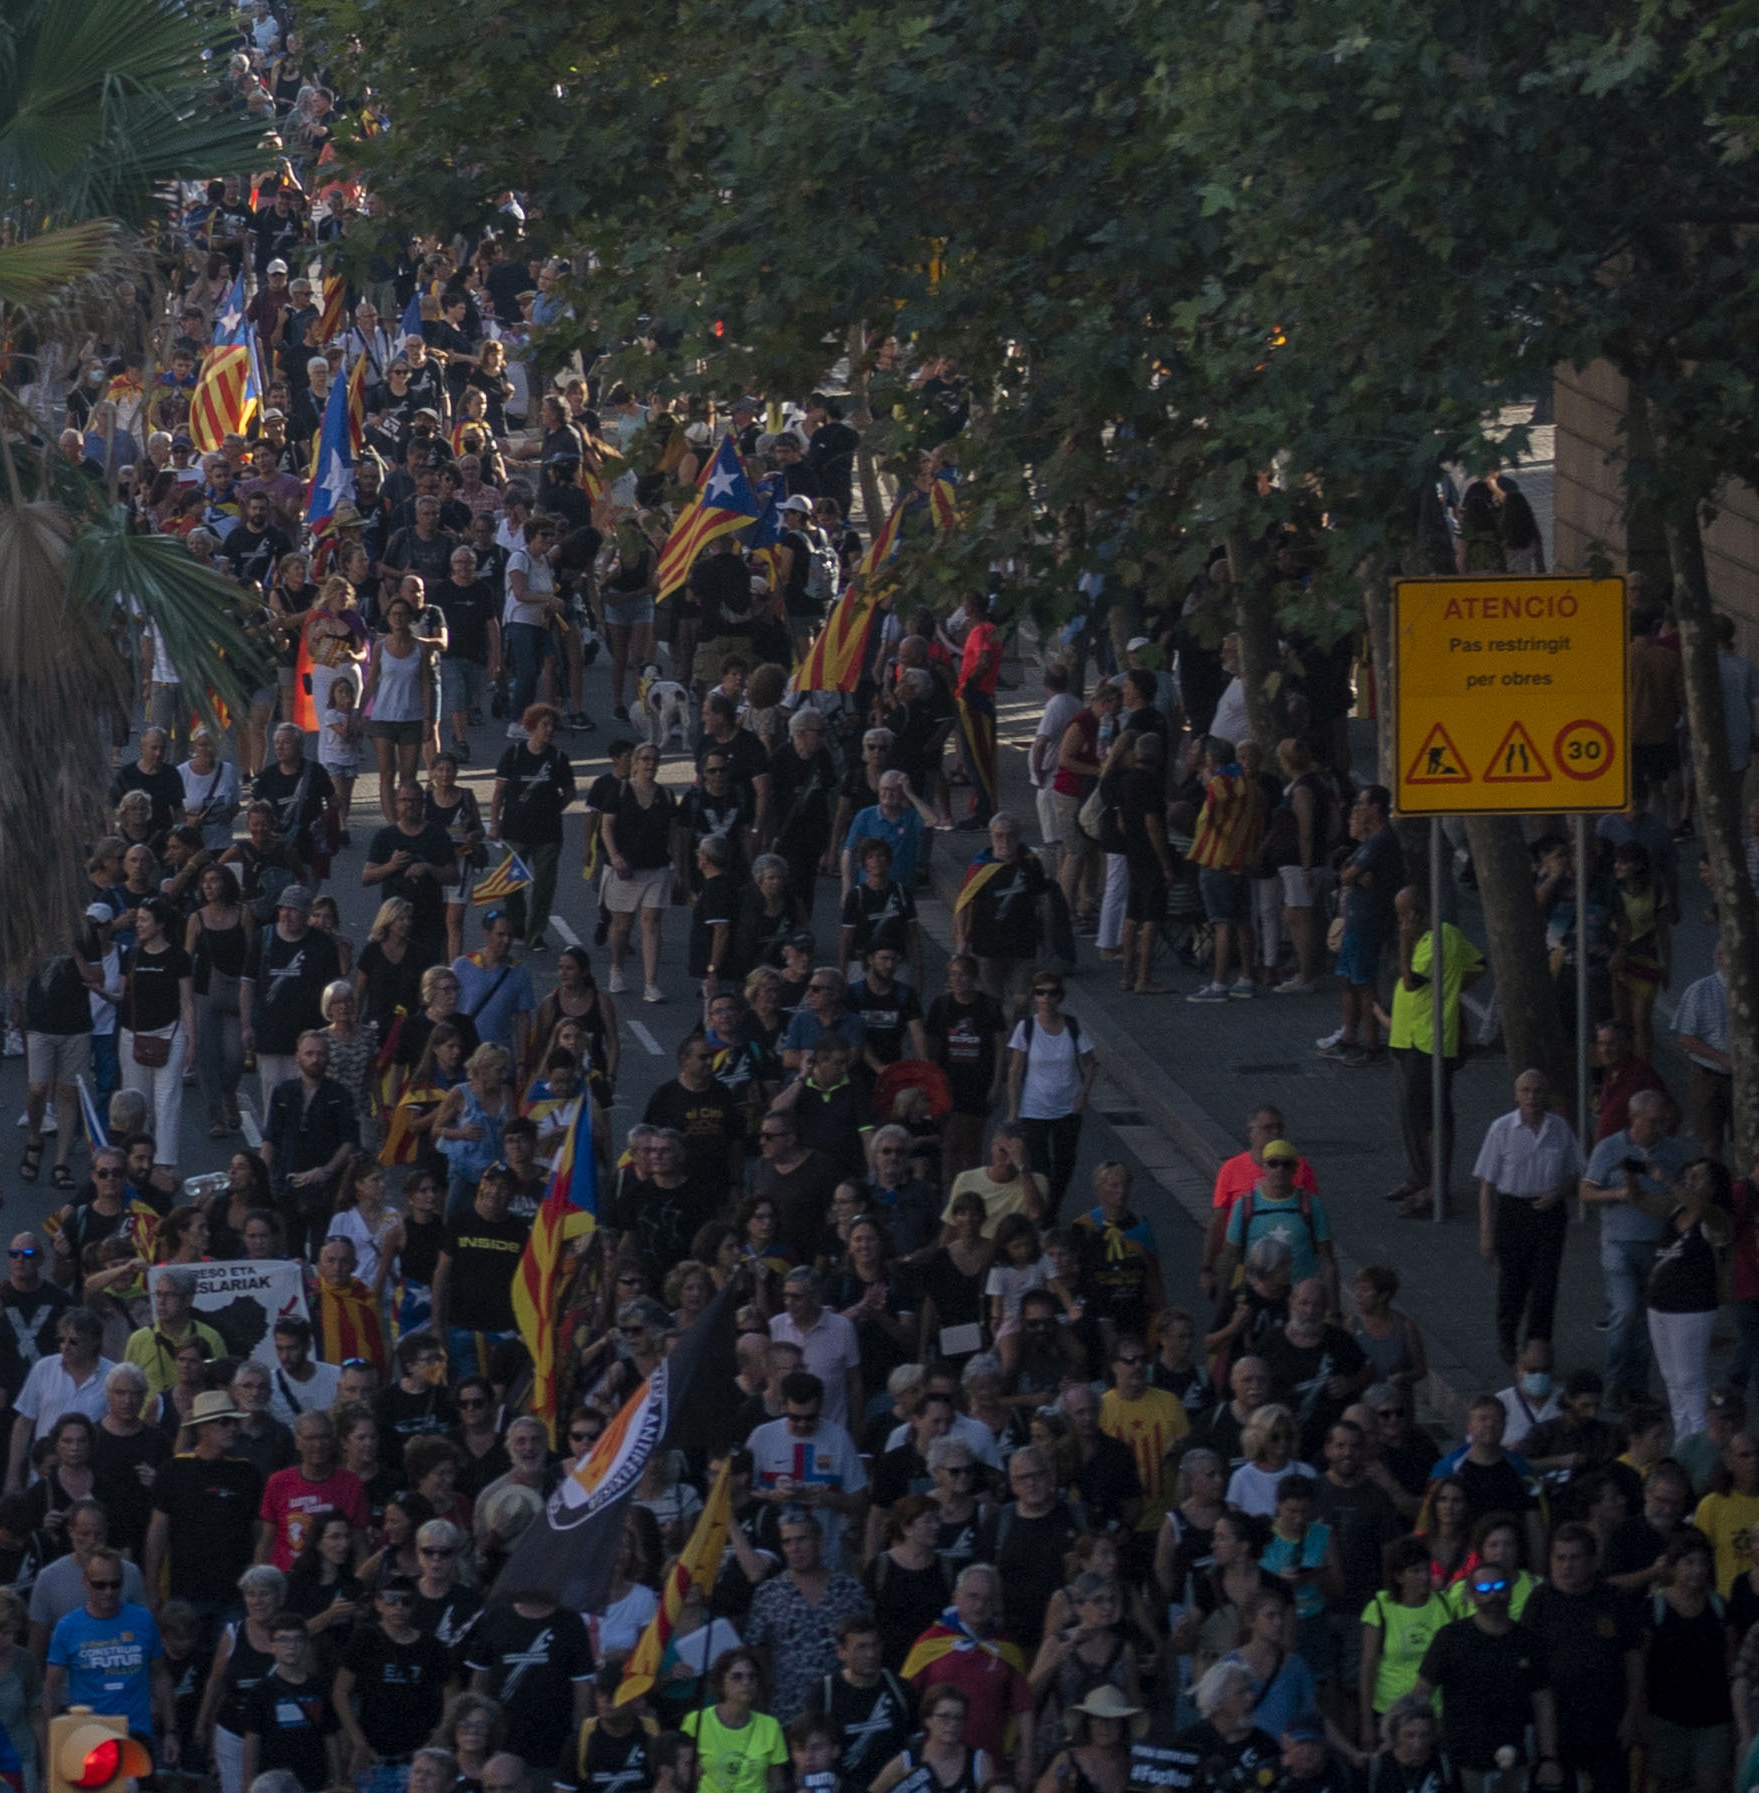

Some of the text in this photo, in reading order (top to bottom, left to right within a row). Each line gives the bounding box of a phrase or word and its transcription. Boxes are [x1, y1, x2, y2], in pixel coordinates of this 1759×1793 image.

[1443, 589, 1580, 620] ATENCIÓ
[1449, 635, 1572, 654] Pas restringit
[1466, 671, 1553, 691] per obres
[1568, 740, 1602, 761] 30
[230, 1266, 257, 1278] ETA
